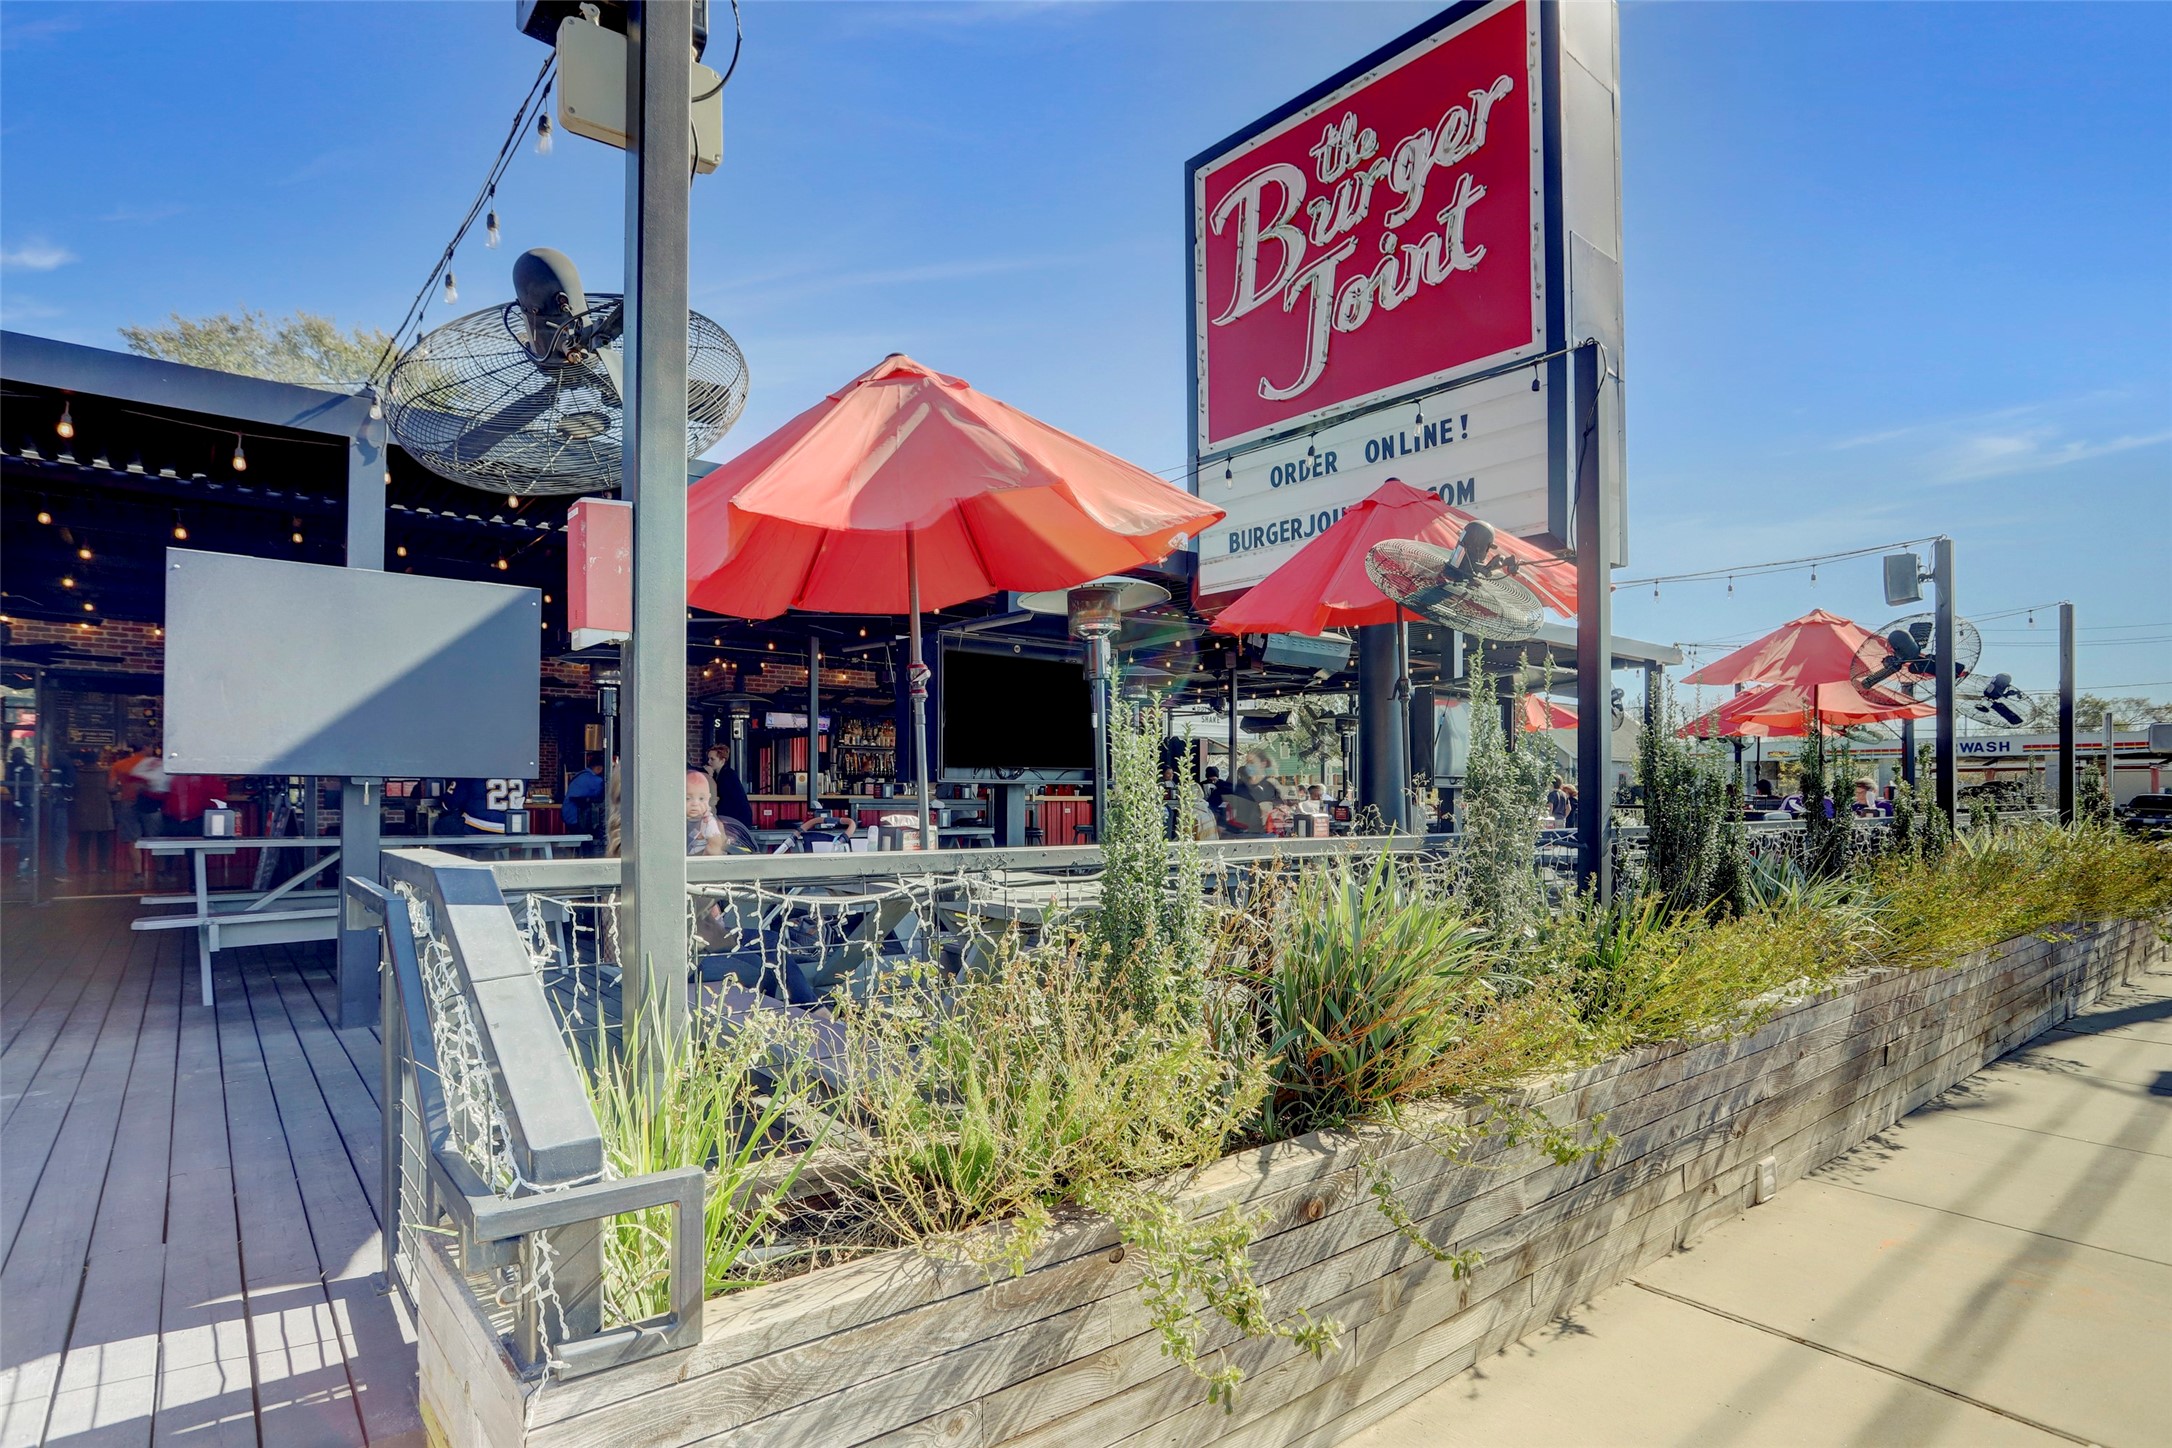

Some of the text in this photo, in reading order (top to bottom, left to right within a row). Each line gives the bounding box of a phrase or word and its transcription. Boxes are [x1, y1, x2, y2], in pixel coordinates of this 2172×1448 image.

[1309, 111, 1379, 183] the
[1210, 74, 1514, 326] Burger
[1258, 172, 1488, 400] Joint
[1270, 451, 1338, 488] ORDER
[1426, 477, 1475, 506] OM
[1201, 715, 1221, 724] SHAKE
[1959, 741, 2010, 753] WASH
[485, 779, 524, 811] 22
